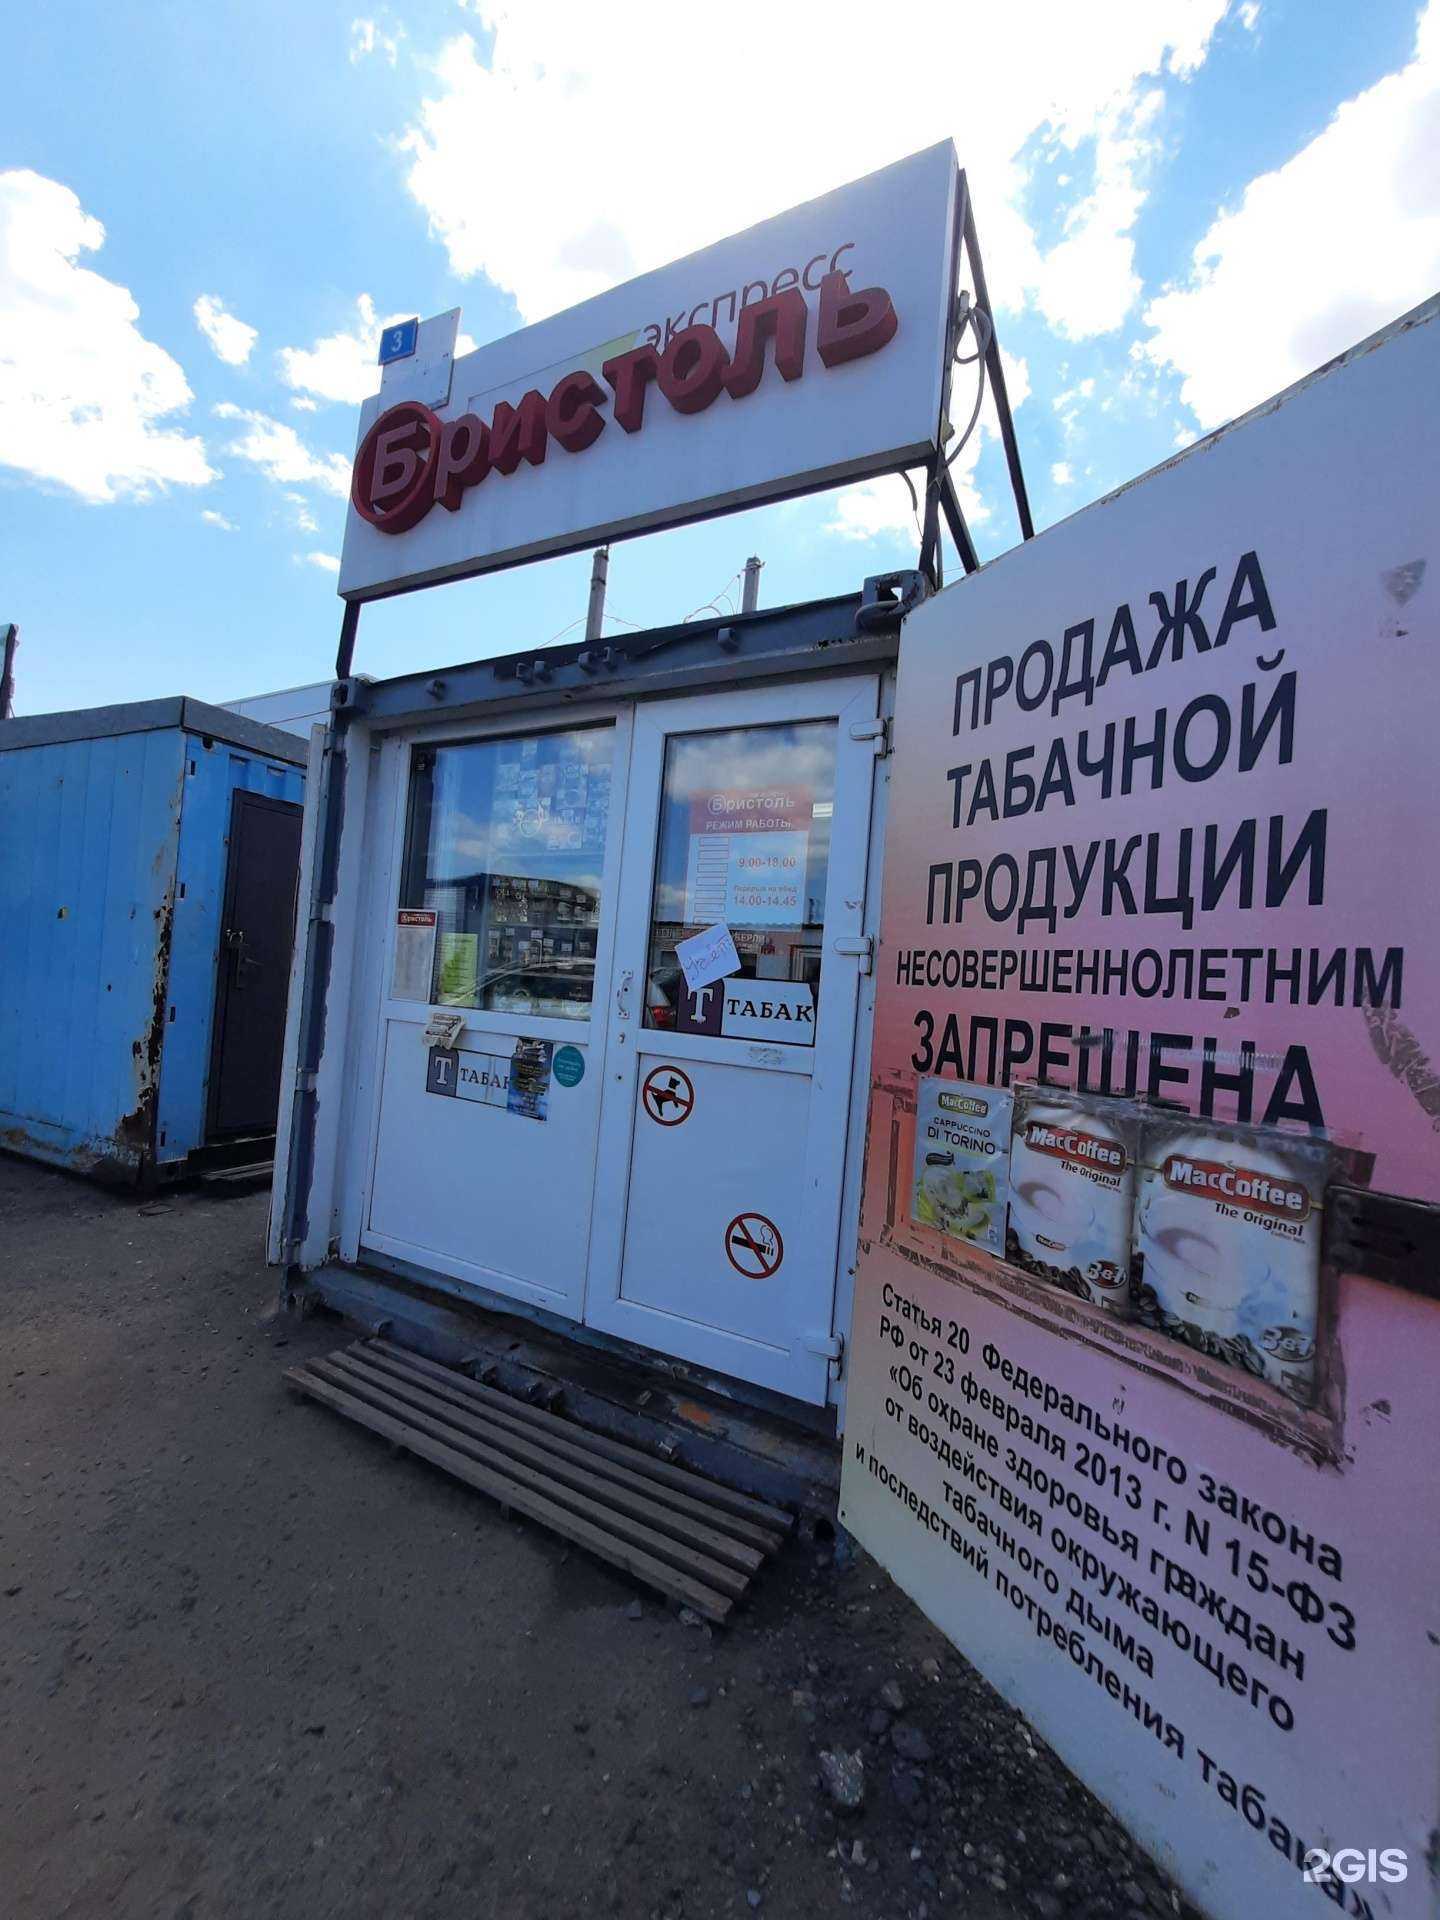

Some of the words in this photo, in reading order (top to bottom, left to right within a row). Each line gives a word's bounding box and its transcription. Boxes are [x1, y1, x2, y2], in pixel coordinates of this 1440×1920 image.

[391, 330, 403, 352] 3
[352, 270, 898, 533] Бристоль
[952, 550, 1277, 737] ПРОДАЖА
[947, 648, 1298, 828] ТАБАЧНОЙ
[706, 820, 743, 831] РЕЖИМ
[926, 808, 1328, 934] ПРОДУКЦИИ
[896, 946, 1404, 1010] НЕСОВЕРШЕННОЛЕТНИМ
[727, 998, 814, 1023] ТАБАК
[933, 1117, 991, 1138] CAPPUCCINO
[941, 1095, 987, 1114] MacCoffee
[928, 1126, 939, 1140] DI
[943, 1130, 996, 1155] TORINO
[1029, 1126, 1121, 1166] MacCoffee
[1060, 1160, 1078, 1173] The
[1080, 1167, 1121, 1187] Original
[1169, 1160, 1303, 1210] MacCoffee
[1215, 1203, 1239, 1218] The
[1244, 1211, 1304, 1237] Original
[882, 1283, 942, 1338] Статья
[947, 1321, 970, 1354] 20
[982, 1343, 1187, 1485] Федерального
[1198, 1473, 1343, 1582] закона
[880, 1315, 904, 1348] РФ
[909, 1341, 929, 1366] от
[933, 1351, 955, 1384] 23
[960, 1371, 1066, 1461] февраля
[1074, 1442, 1142, 1510] 2013
[1153, 1499, 1171, 1532] г.
[1185, 1509, 1210, 1556] N
[1225, 1538, 1356, 1652] 15-ФЗ
[889, 1365, 922, 1400] «Об
[928, 1392, 999, 1458] охране
[1005, 1448, 1138, 1561] здоровья
[1150, 1549, 1305, 1681] граждан
[885, 1397, 904, 1422] от
[908, 1413, 1043, 1536] воздействия
[1051, 1528, 1294, 1731] окружающего
[942, 1480, 1060, 1594] табачного
[1065, 1587, 1154, 1679] дыма
[856, 1443, 865, 1464] и
[869, 1454, 990, 1579] последствий
[996, 1569, 1184, 1760] потребления
